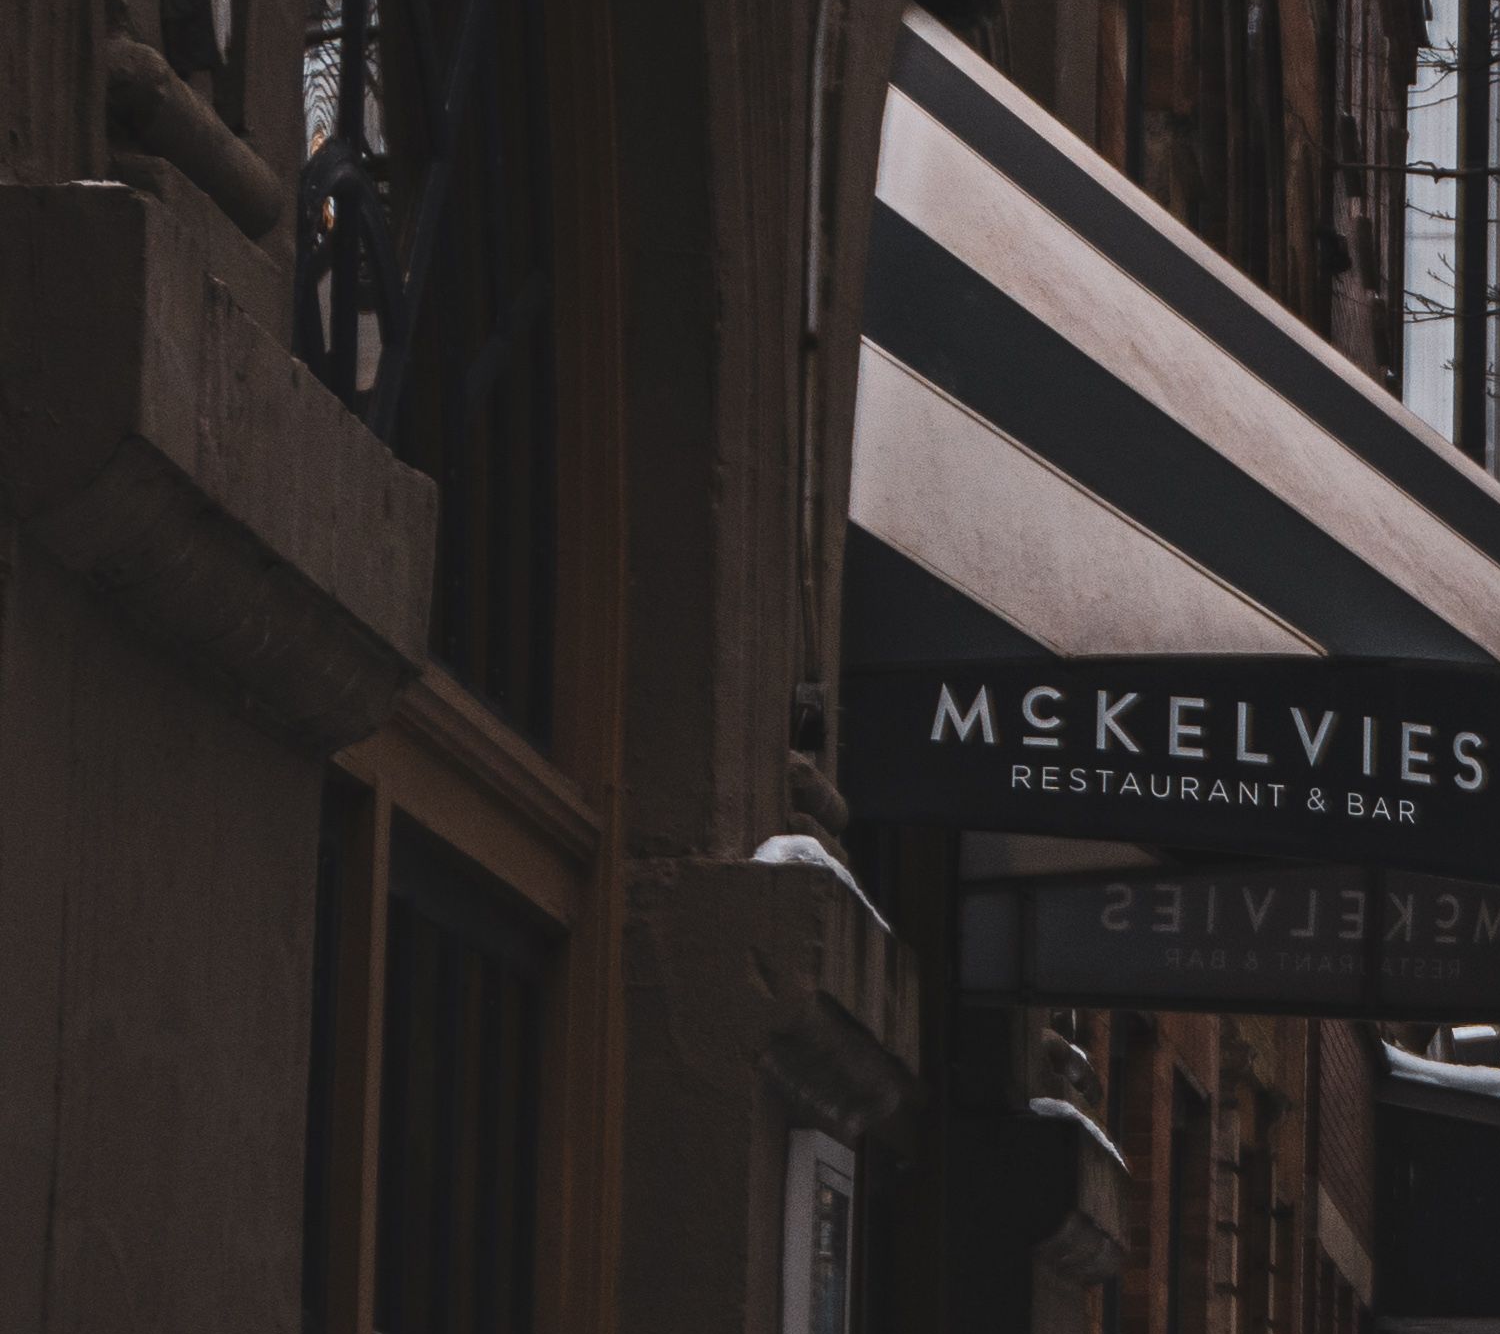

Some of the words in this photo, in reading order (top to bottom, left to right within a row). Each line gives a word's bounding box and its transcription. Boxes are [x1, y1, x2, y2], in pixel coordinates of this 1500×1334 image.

[1010, 763, 1287, 808] RESTAURANT
[1306, 786, 1327, 813] &
[1346, 791, 1417, 825] BAR
